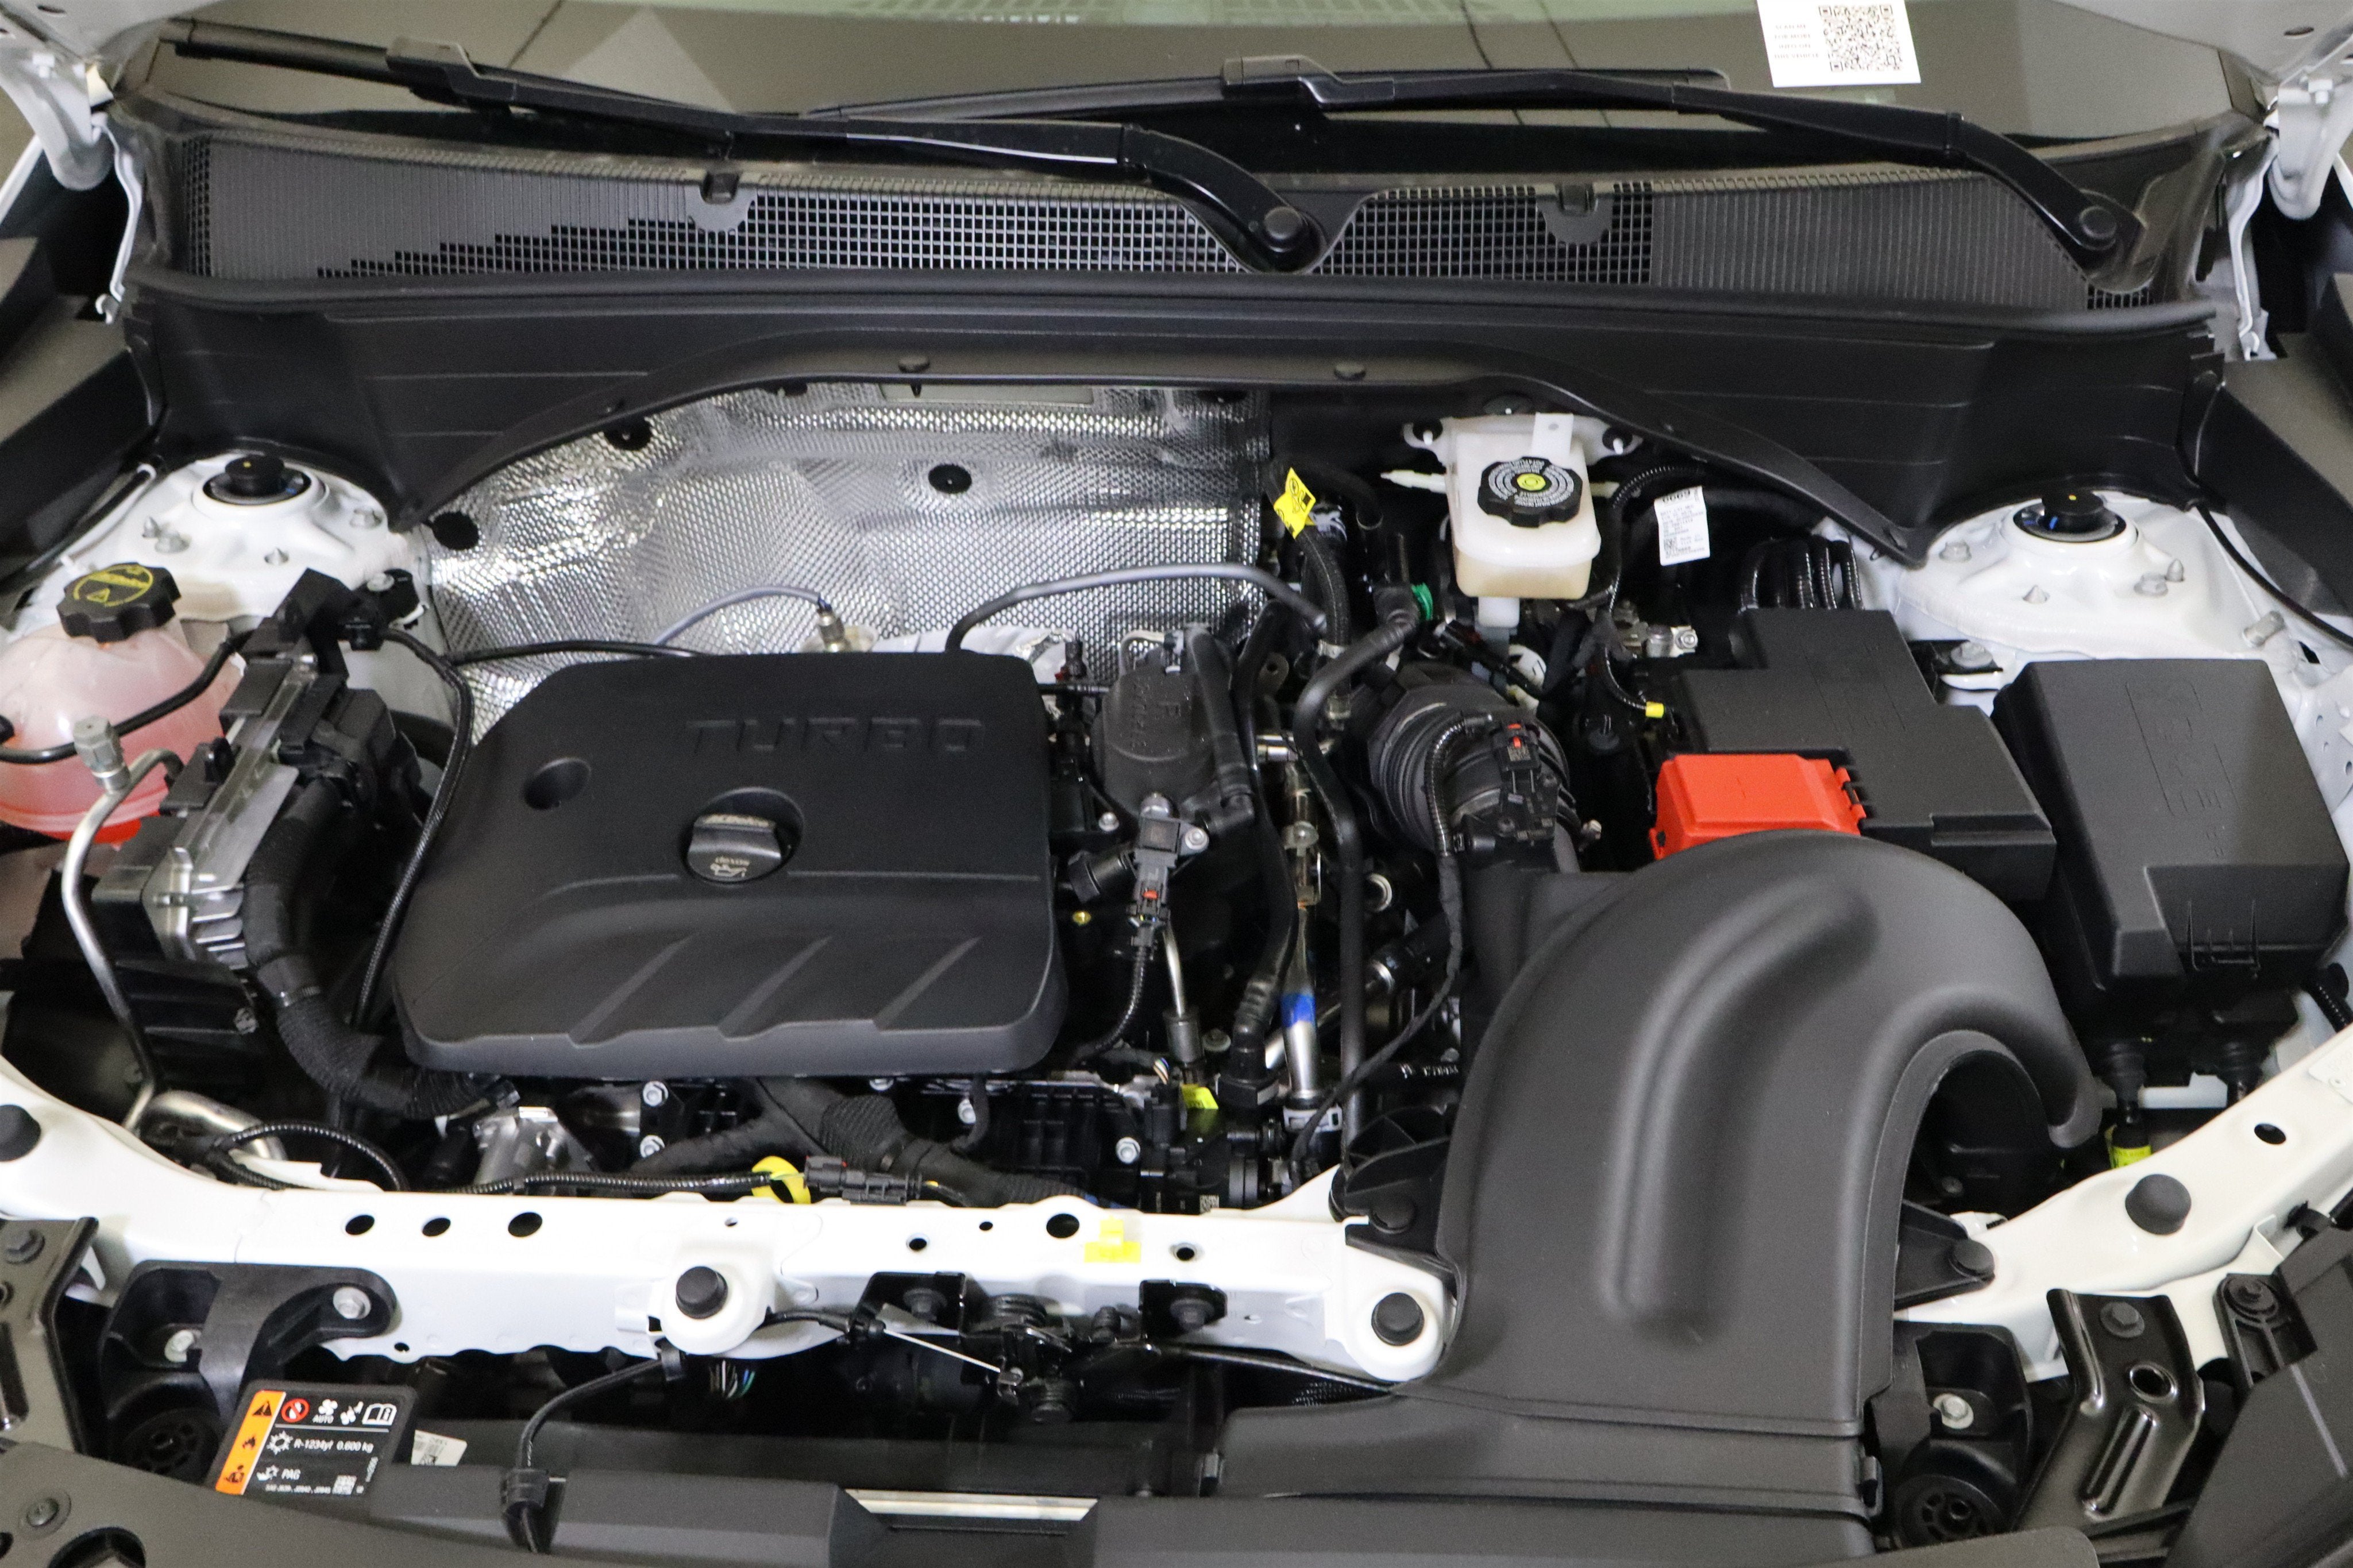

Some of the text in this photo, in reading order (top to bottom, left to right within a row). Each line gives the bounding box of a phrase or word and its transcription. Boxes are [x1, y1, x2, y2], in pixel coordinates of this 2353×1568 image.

[686, 717, 985, 753] TURBO
[313, 1415, 334, 1424] AUTO
[281, 1469, 300, 1480] PAG
